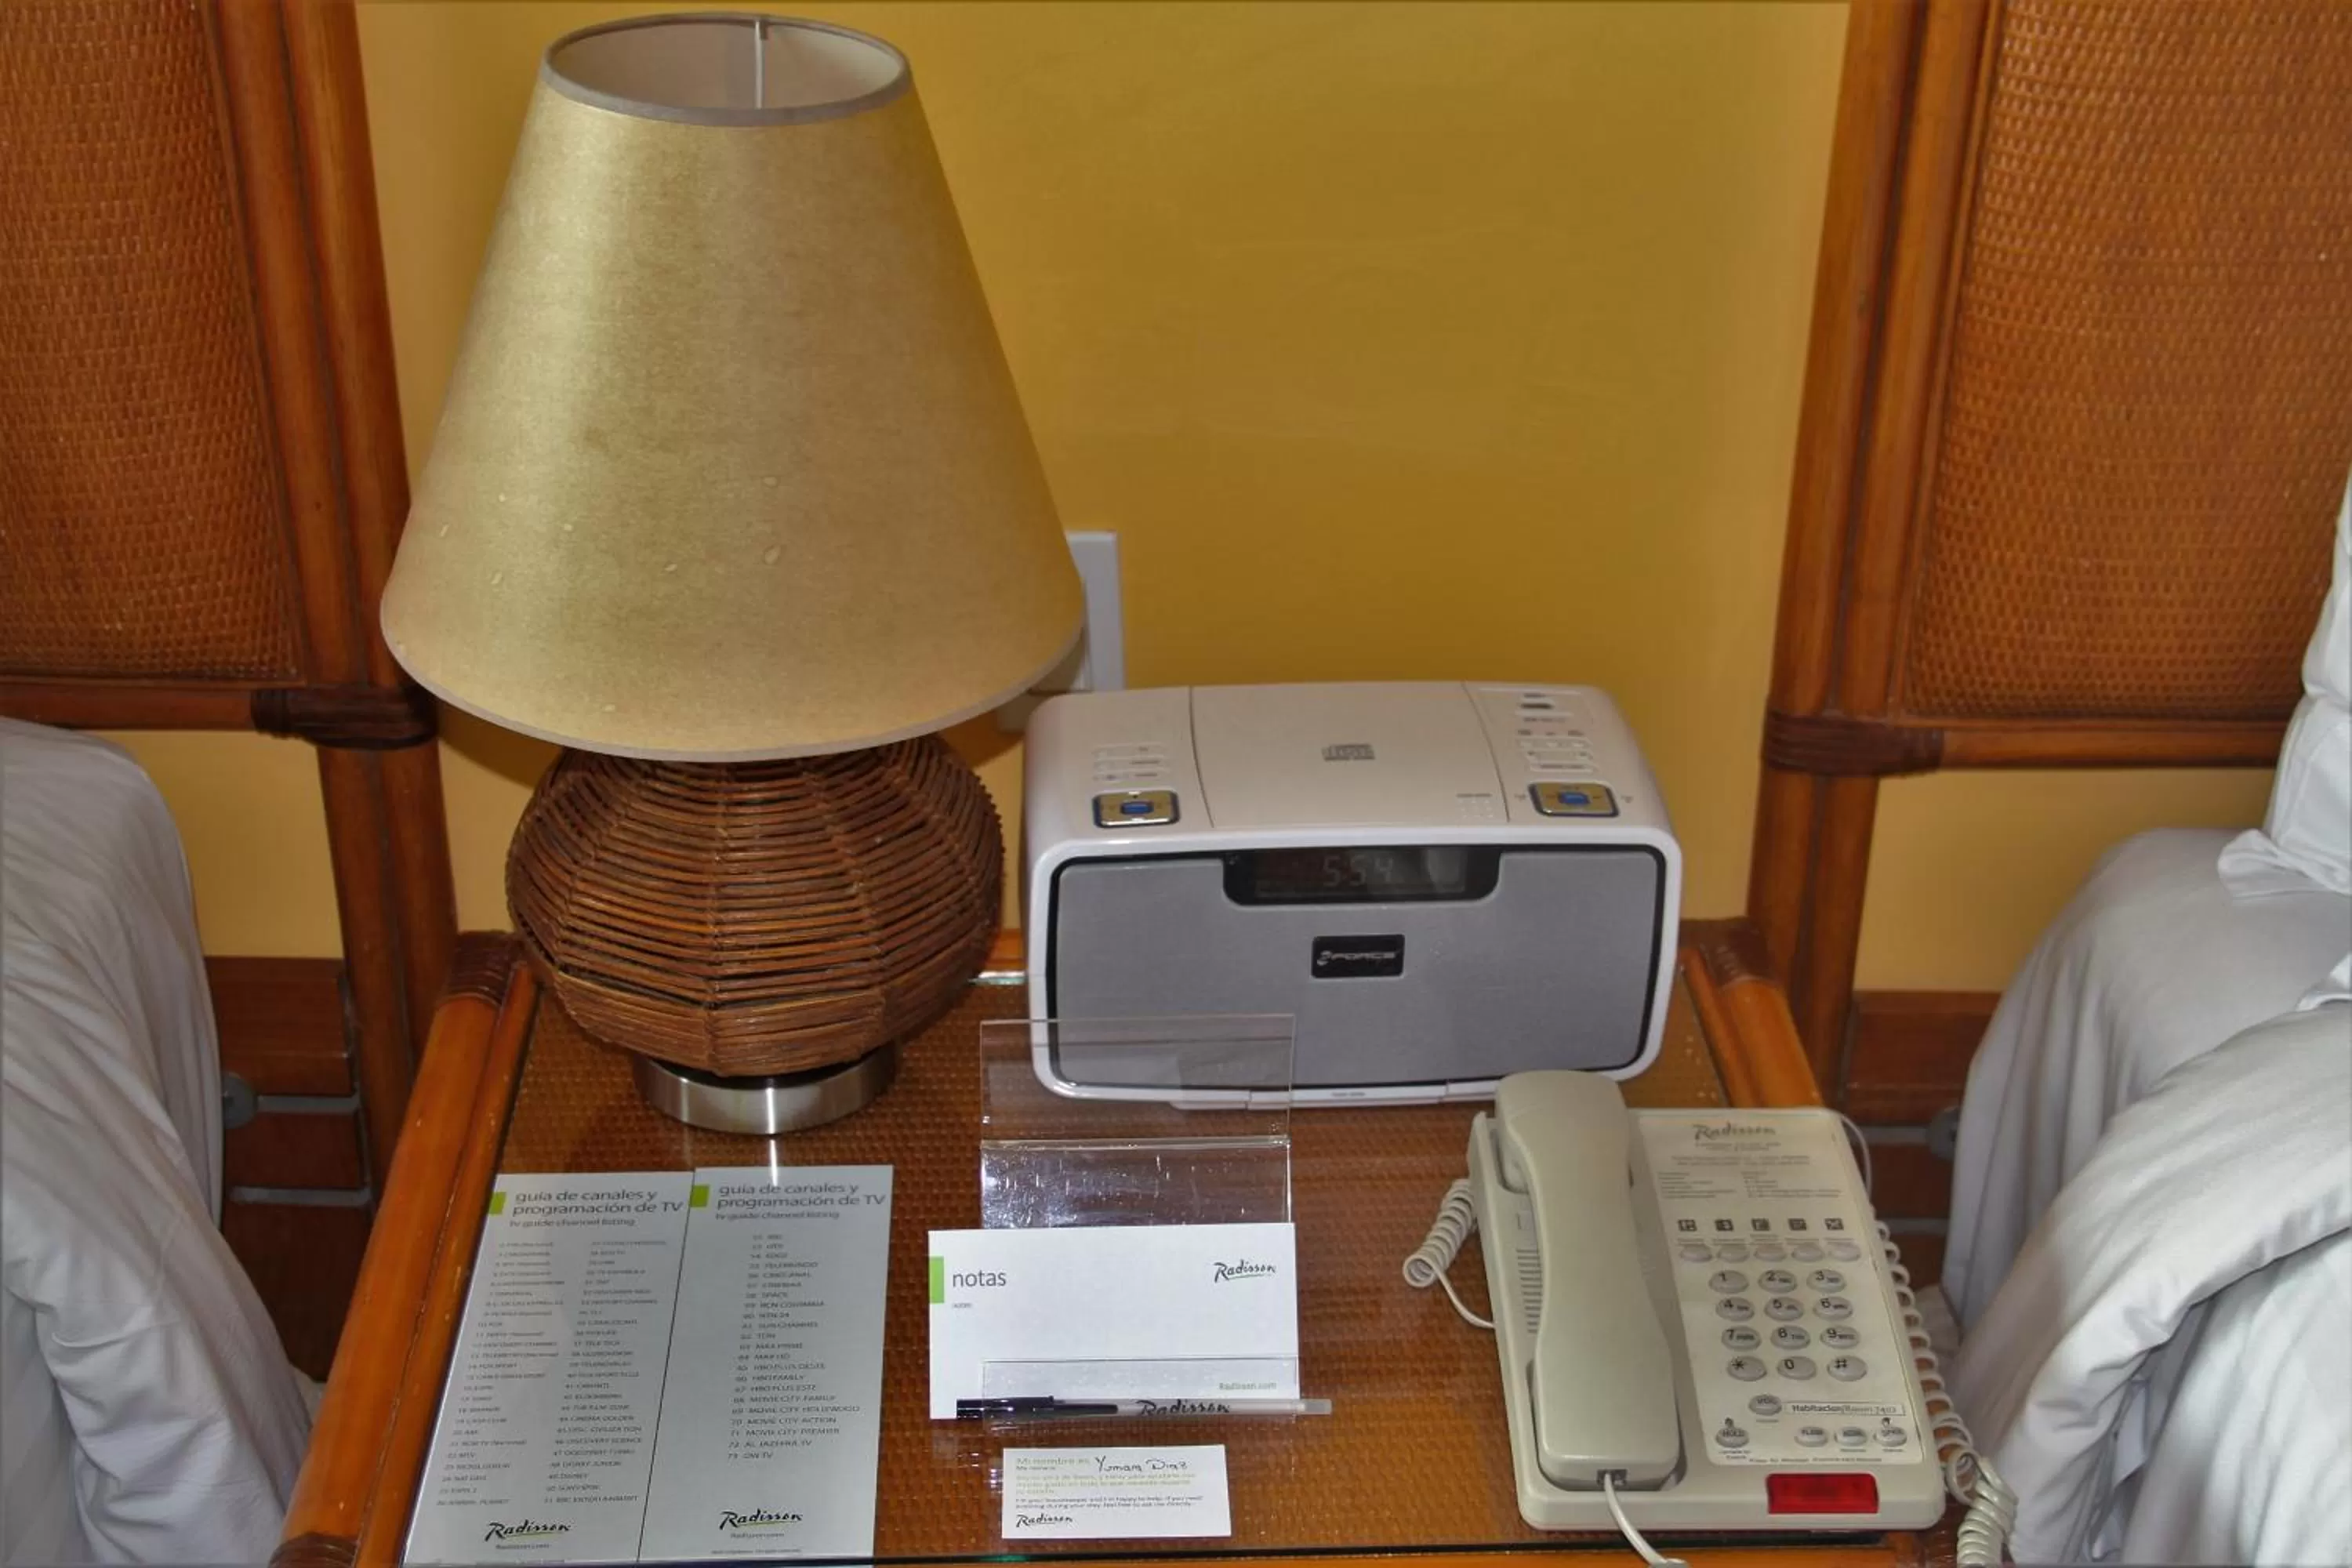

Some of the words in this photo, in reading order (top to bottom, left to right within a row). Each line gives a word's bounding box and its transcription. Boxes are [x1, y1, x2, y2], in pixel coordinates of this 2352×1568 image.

[1692, 1120, 1776, 1140] Radisson
[515, 1190, 552, 1203] guía
[556, 1191, 578, 1201] de
[581, 1189, 644, 1201] canales
[648, 1191, 659, 1201] y
[719, 1185, 755, 1196] guía
[759, 1185, 781, 1193] de
[784, 1182, 845, 1193] canales
[848, 1185, 858, 1196] y
[513, 1201, 632, 1216] programación
[634, 1201, 657, 1213] de
[662, 1201, 684, 1212] TV
[717, 1195, 834, 1210] programación
[838, 1195, 860, 1206] de
[865, 1194, 886, 1205] TV
[1213, 1258, 1277, 1283] Radisson
[1719, 1271, 1727, 1283] 1
[1766, 1271, 1777, 1282] 2
[1815, 1269, 1825, 1281] 3
[952, 1269, 1007, 1287] notas
[1724, 1298, 1734, 1309] 4
[1820, 1298, 1831, 1308] 6
[1726, 1328, 1735, 1341] 7
[1777, 1327, 1788, 1338] 8
[1826, 1327, 1838, 1338] 9
[1784, 1358, 1795, 1370] 0
[1135, 1398, 1230, 1416] Radisson
[719, 1508, 804, 1530] Radisson
[1015, 1512, 1073, 1528] Radisson
[485, 1519, 572, 1542] Radisson
